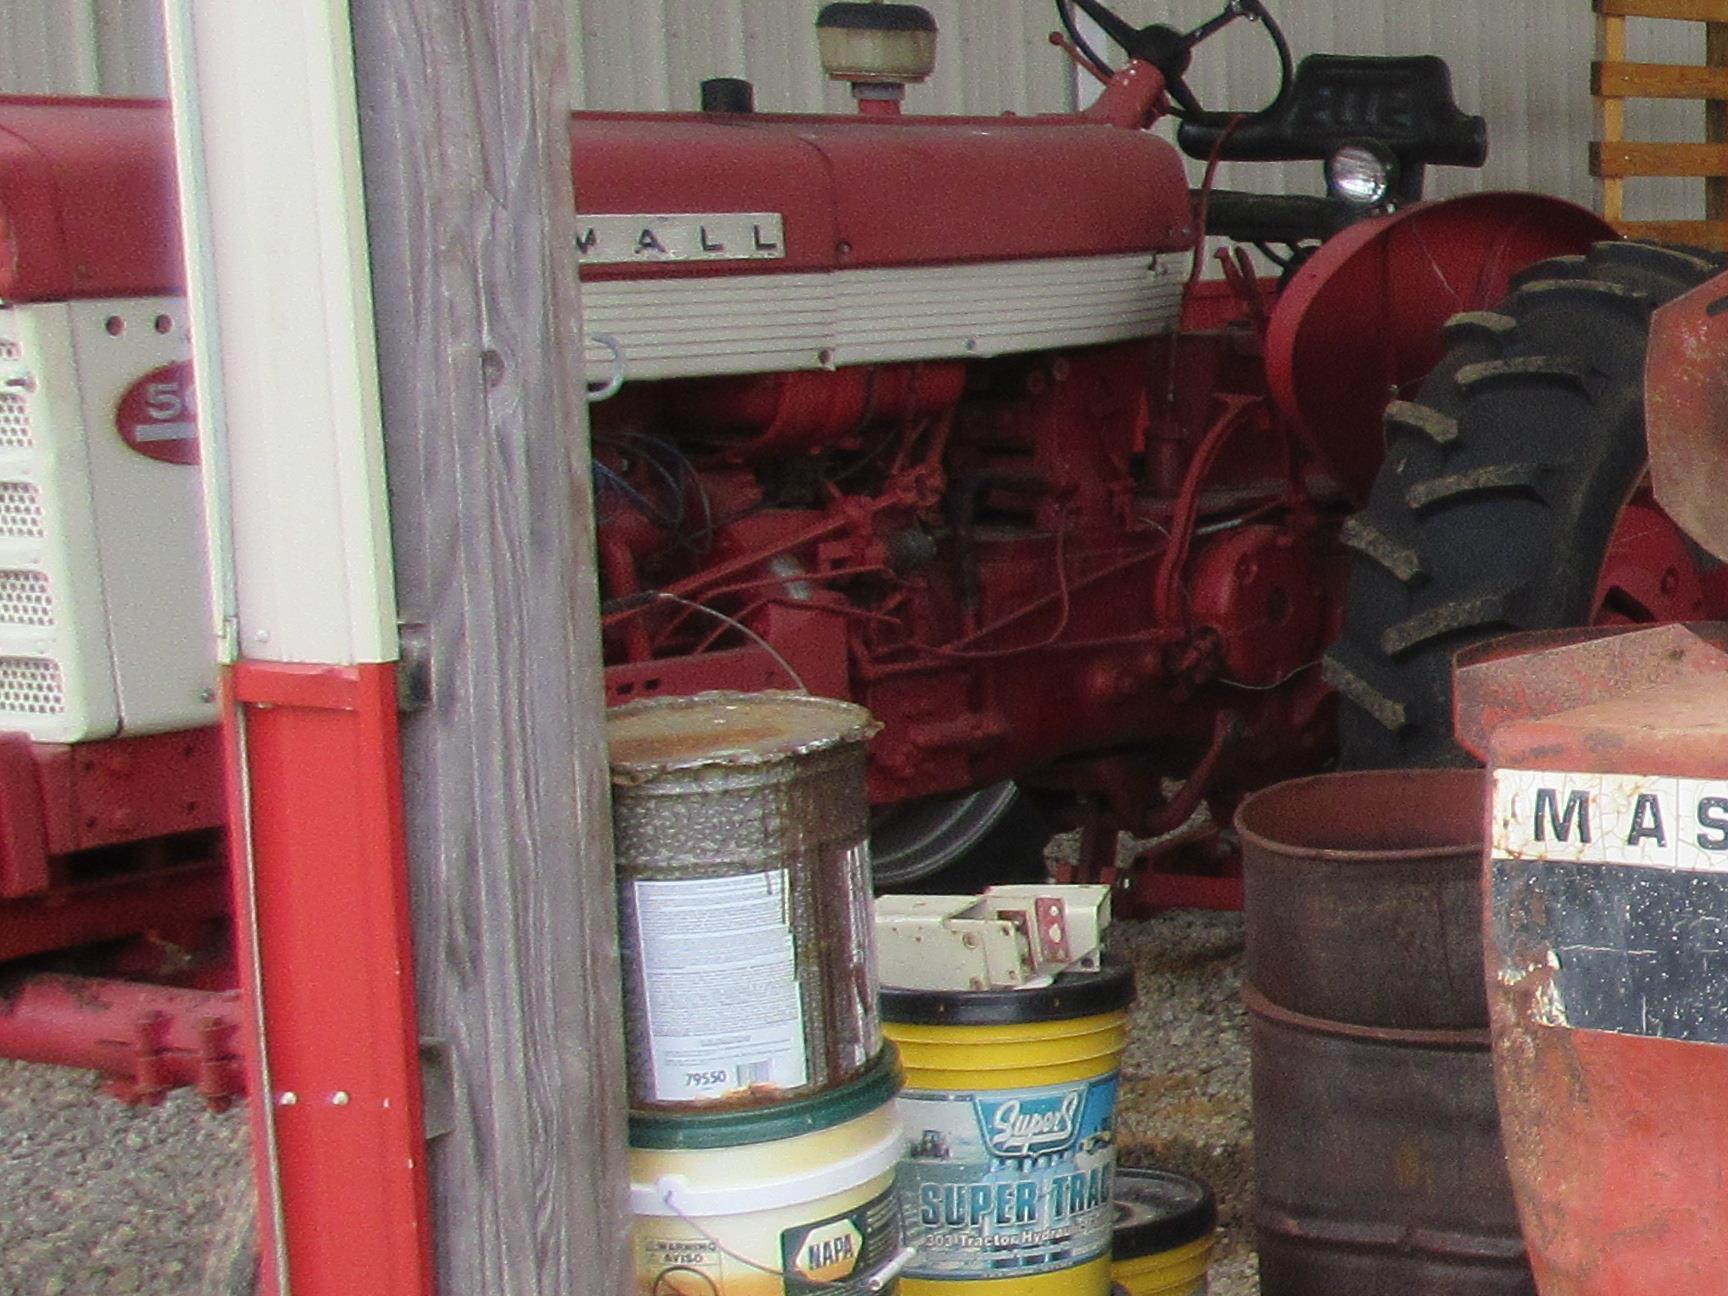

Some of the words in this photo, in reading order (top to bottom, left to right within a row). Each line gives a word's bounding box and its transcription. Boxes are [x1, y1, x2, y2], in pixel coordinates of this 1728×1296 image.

[146, 383, 193, 420] 5
[685, 1070, 727, 1087] 79550
[919, 1182, 1038, 1229] SUPER
[809, 1234, 854, 1270] NAPA
[959, 1232, 1019, 1247] Tractor
